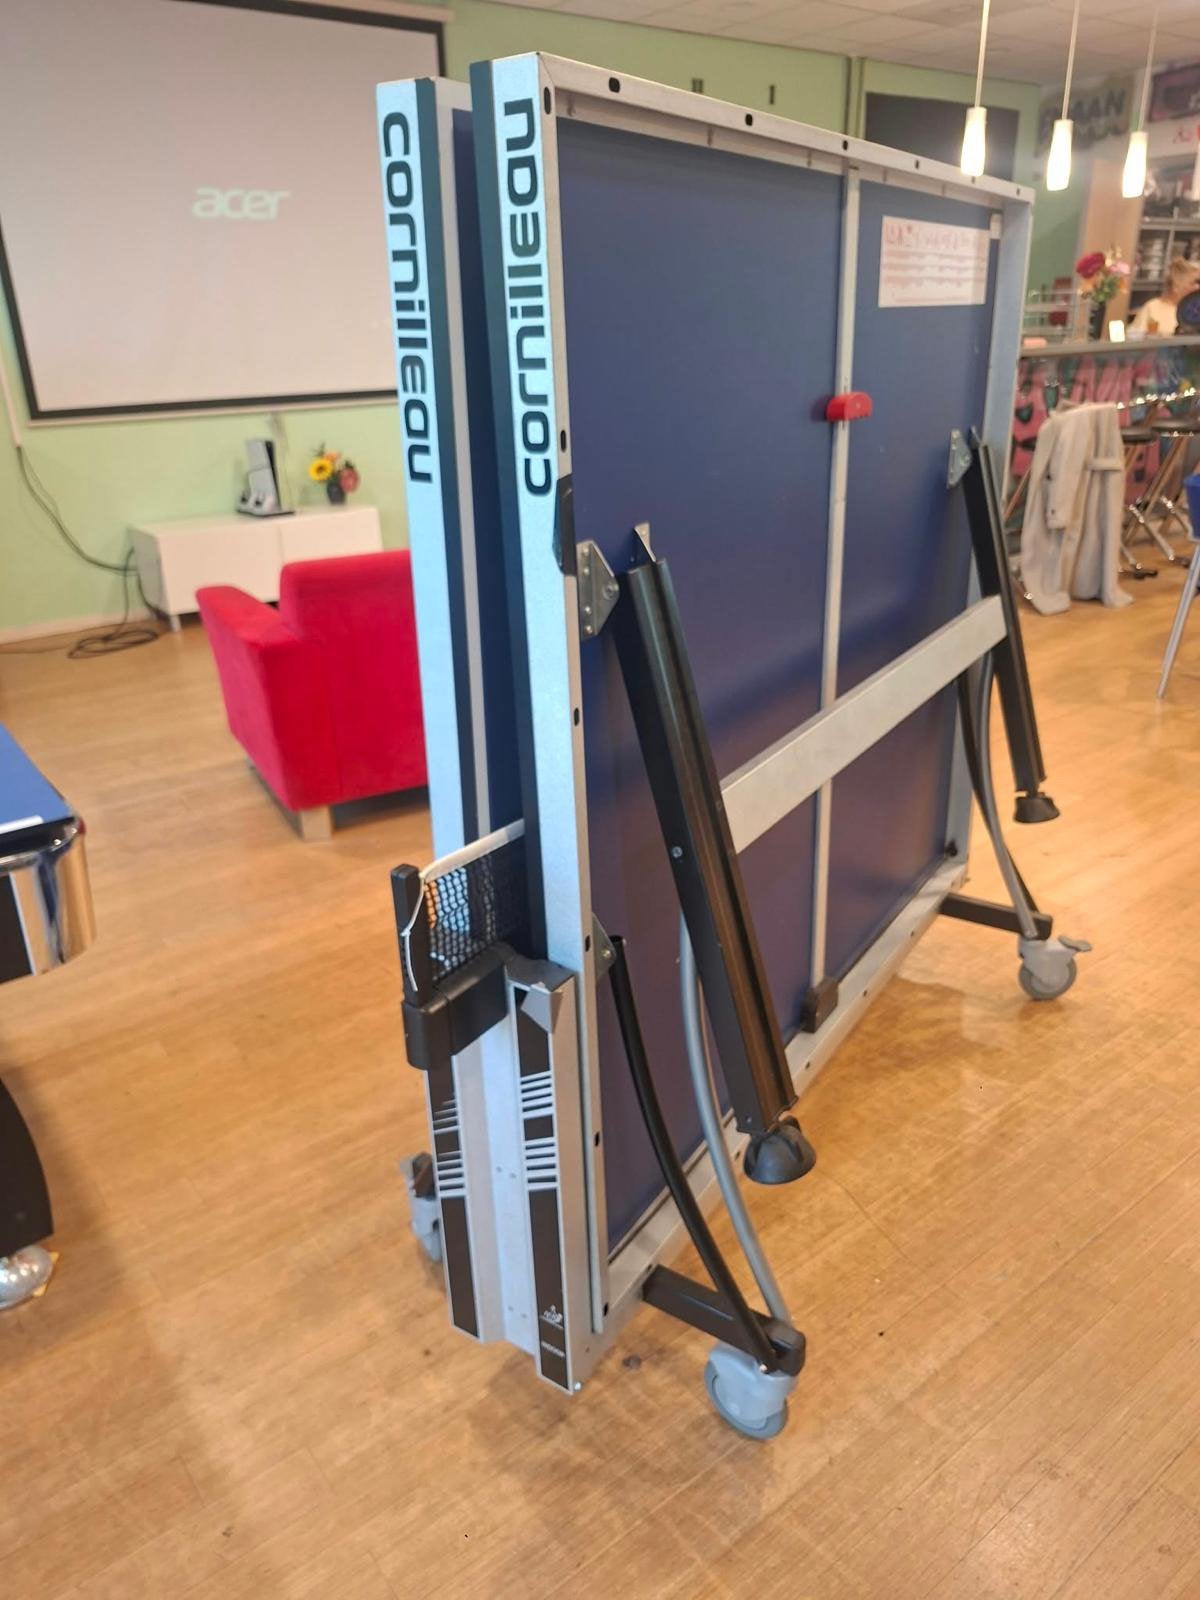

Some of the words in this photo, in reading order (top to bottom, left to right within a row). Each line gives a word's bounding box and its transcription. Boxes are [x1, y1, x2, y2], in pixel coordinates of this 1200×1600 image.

[191, 187, 290, 220] acer
[383, 112, 432, 483] cornilleau
[504, 98, 552, 496] cornilleau
